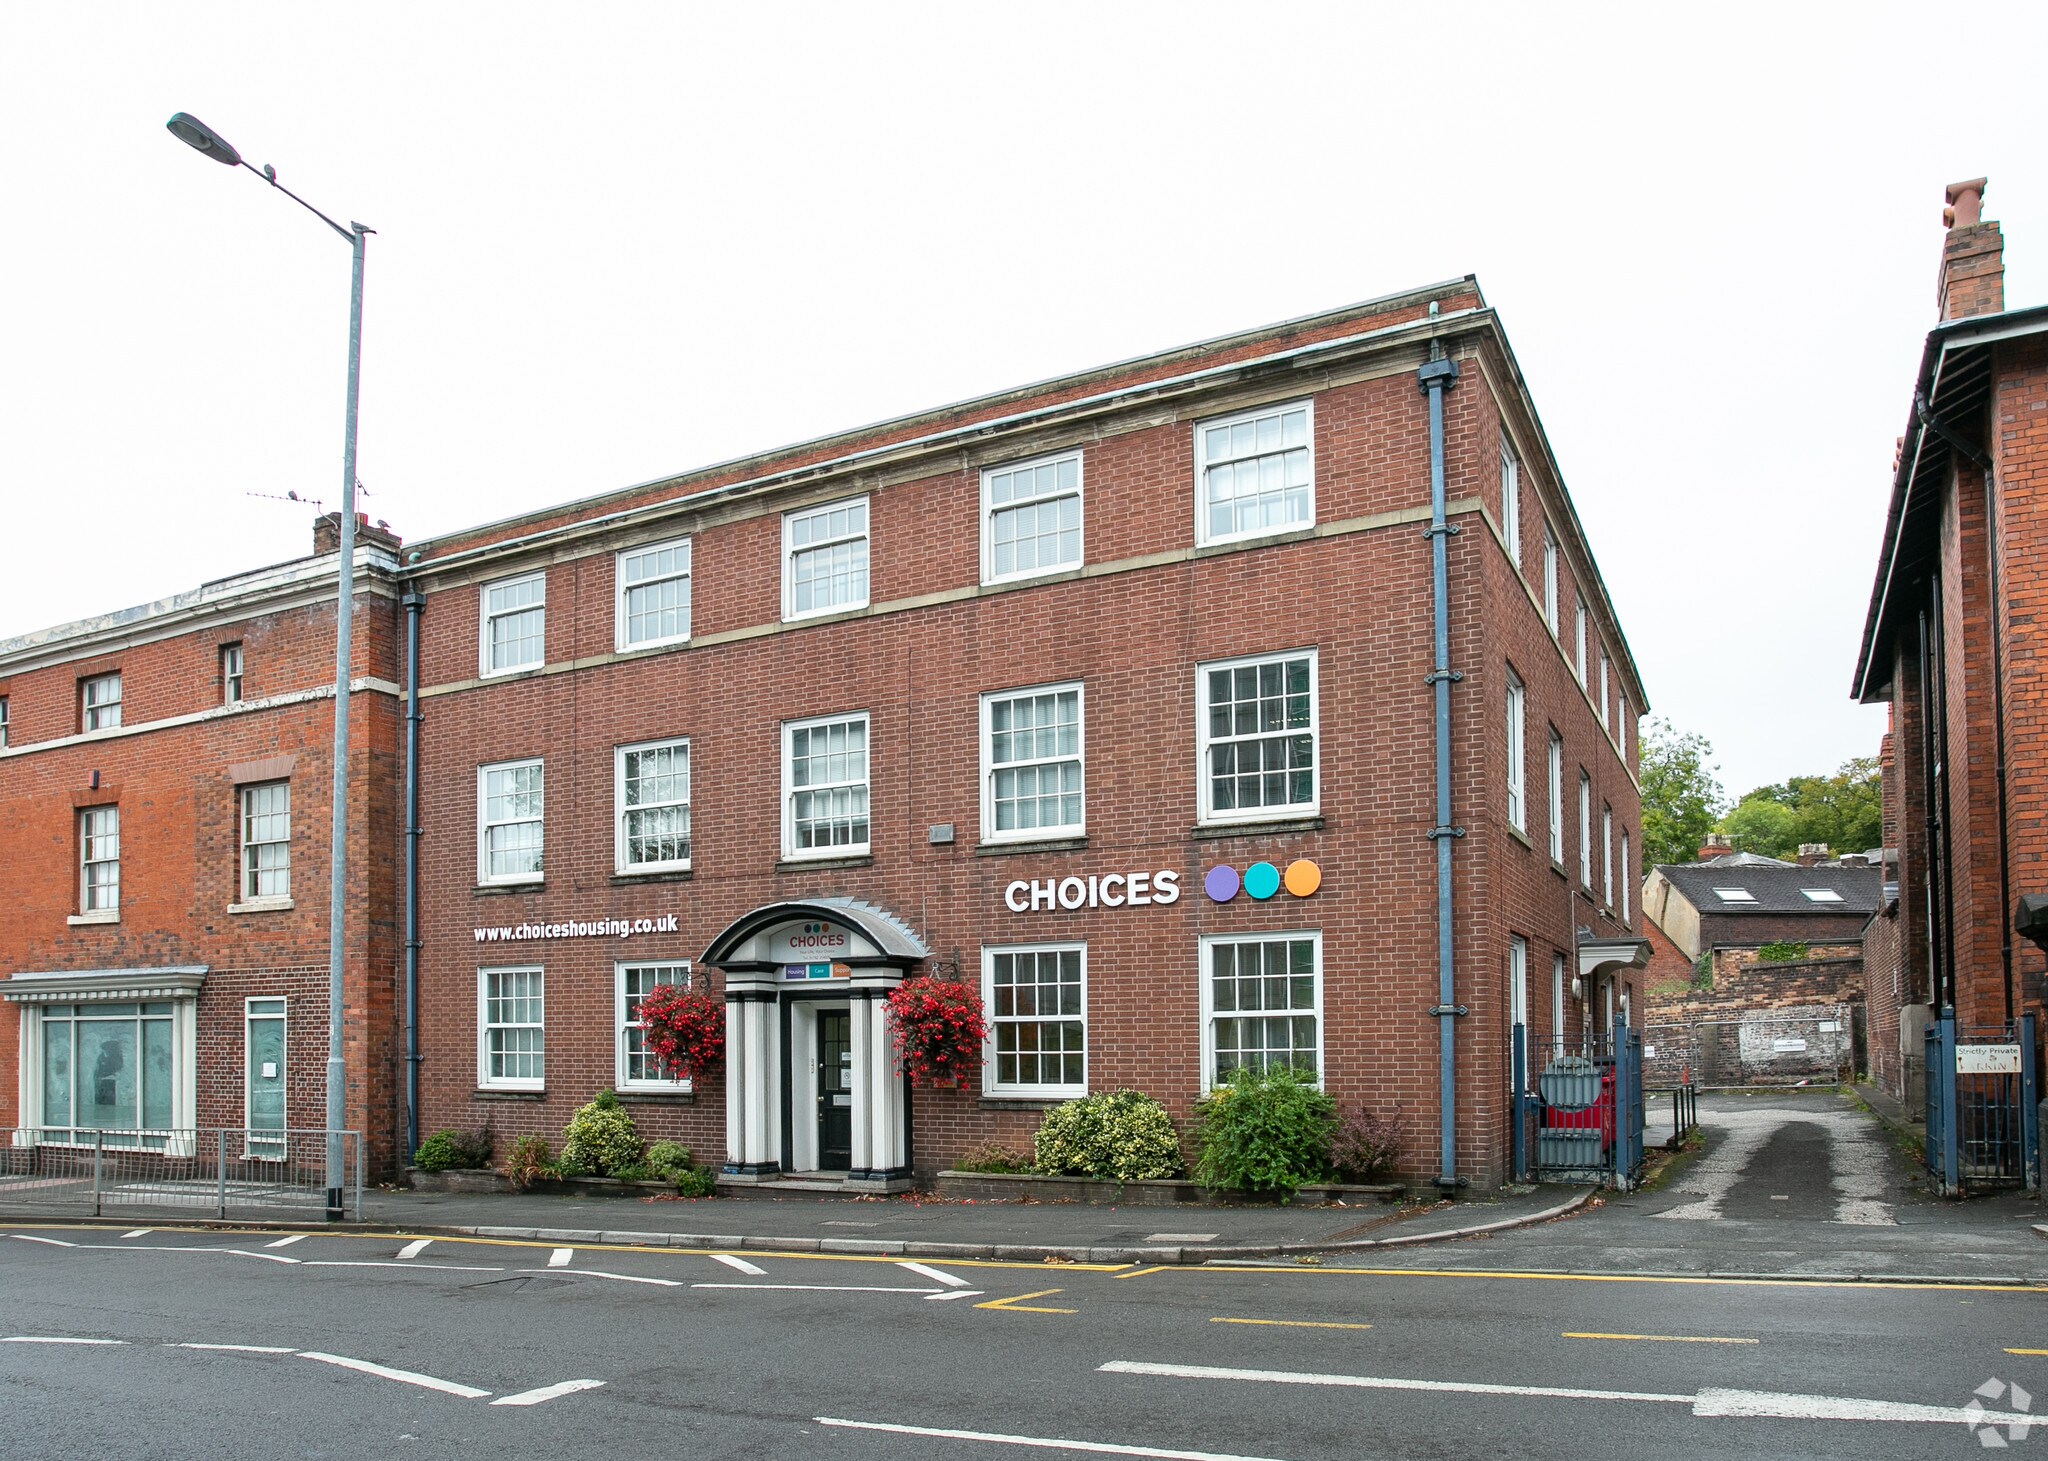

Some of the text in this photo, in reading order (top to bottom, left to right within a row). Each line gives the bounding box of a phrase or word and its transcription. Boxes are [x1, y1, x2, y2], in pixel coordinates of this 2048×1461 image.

[1004, 870, 1180, 913] CHOICES
[474, 913, 679, 942] www.choiceshousing.co.uk
[790, 934, 844, 947] CHOICES
